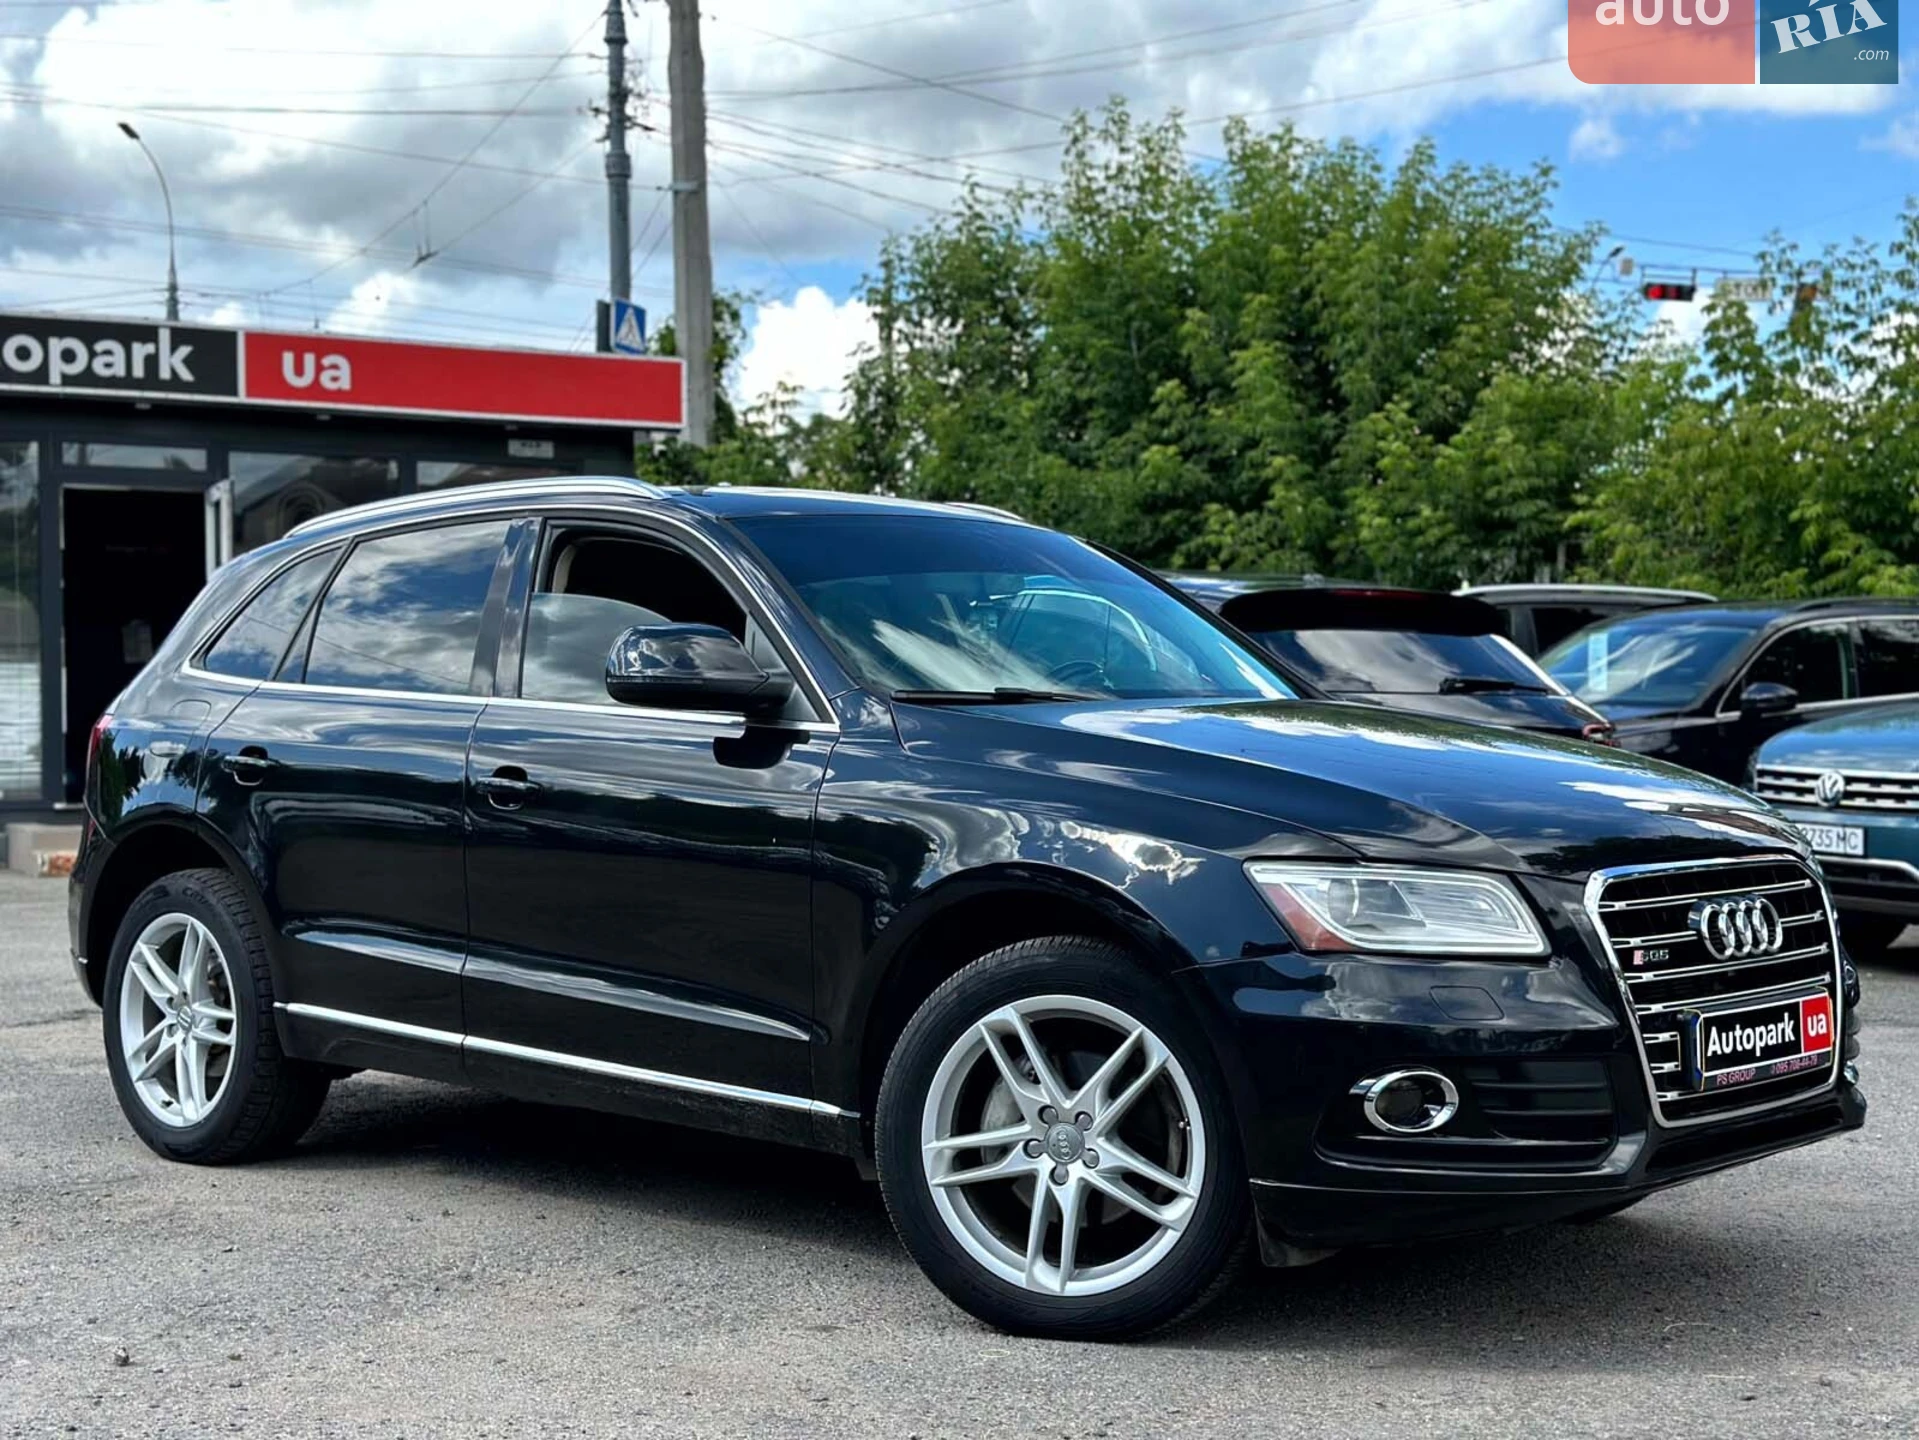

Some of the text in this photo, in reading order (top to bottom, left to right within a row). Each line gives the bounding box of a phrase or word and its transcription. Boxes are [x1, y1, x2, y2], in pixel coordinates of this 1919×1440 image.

[1, 326, 352, 392] opark ua
[1706, 1012, 1828, 1057] Autopark ua
